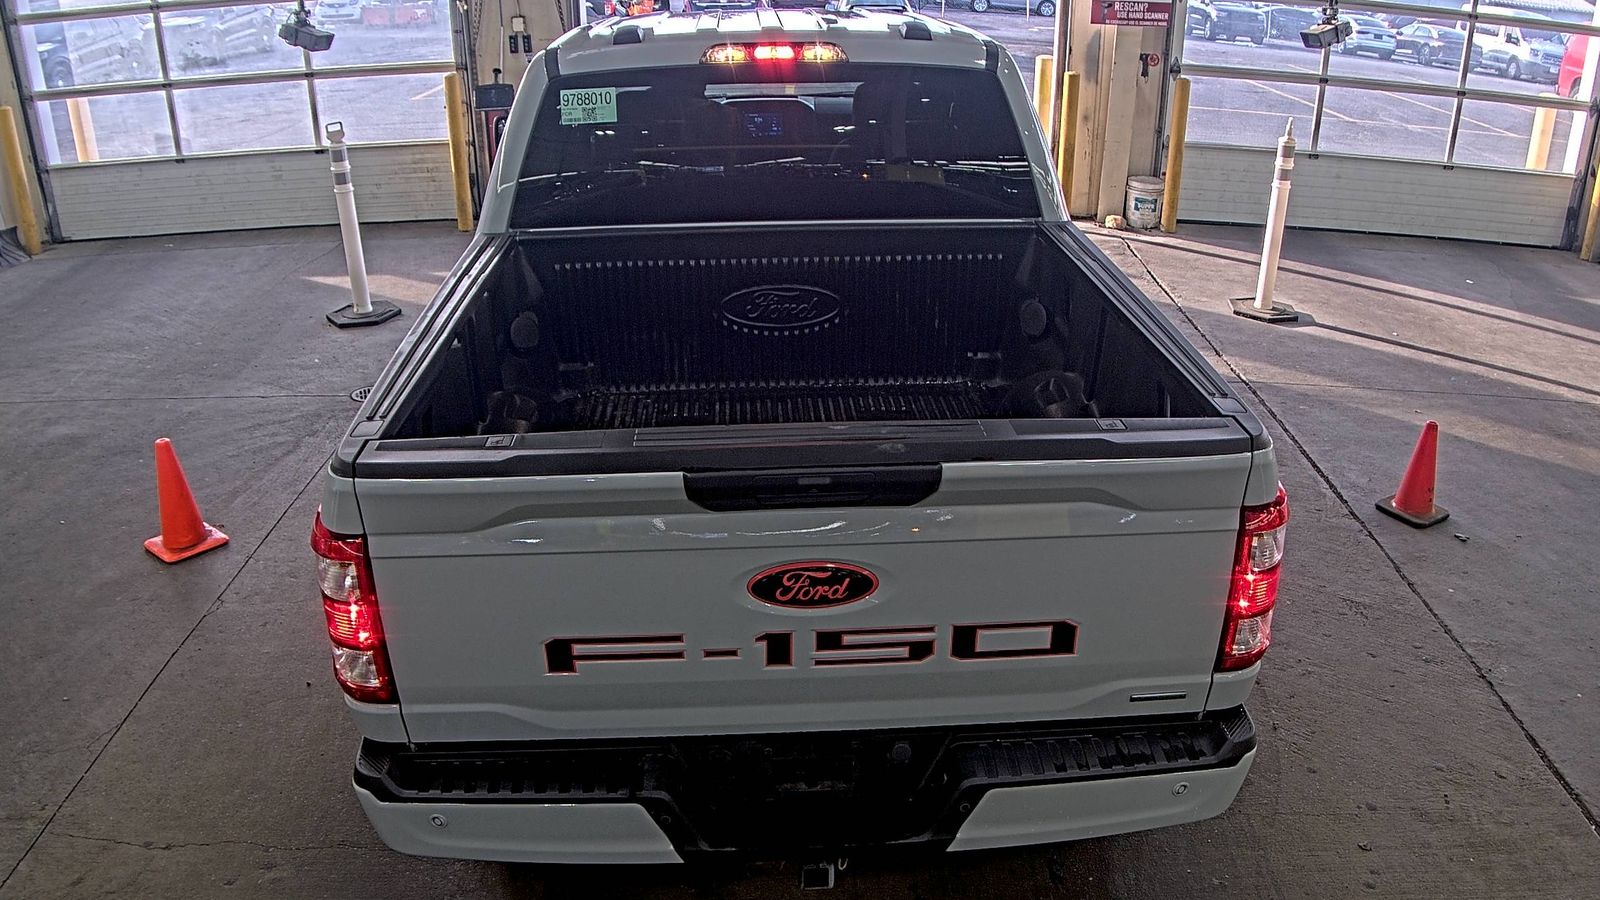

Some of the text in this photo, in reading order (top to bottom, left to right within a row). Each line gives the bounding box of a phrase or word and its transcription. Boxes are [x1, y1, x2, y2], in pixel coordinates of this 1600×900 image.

[1114, 2, 1149, 12] RESCAN?
[1117, 11, 1128, 19] USE
[1144, 12, 1169, 20] SCANNER
[562, 91, 612, 107] 9788010
[745, 290, 819, 318] Ford
[775, 570, 850, 601] Ford
[544, 618, 1080, 676] F-150
